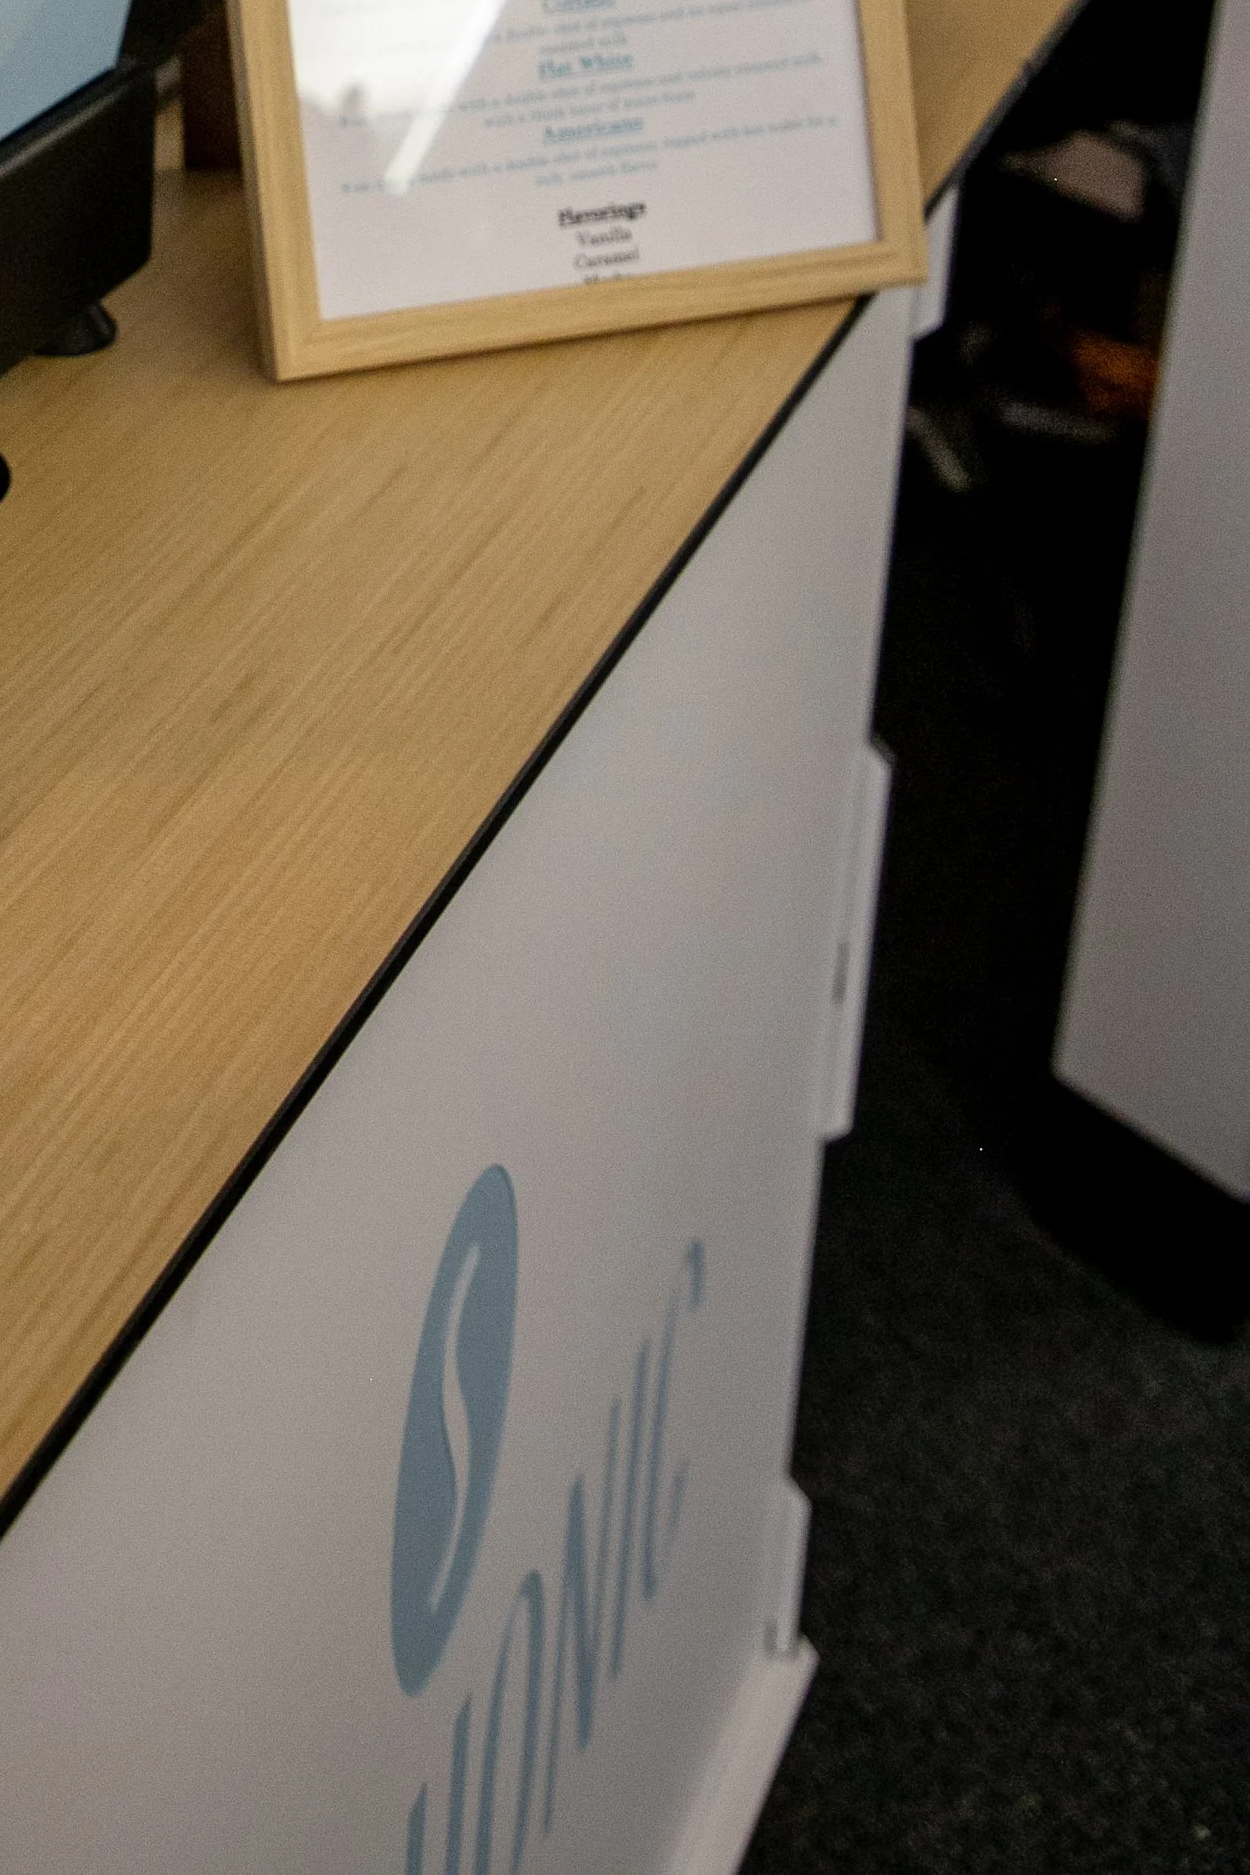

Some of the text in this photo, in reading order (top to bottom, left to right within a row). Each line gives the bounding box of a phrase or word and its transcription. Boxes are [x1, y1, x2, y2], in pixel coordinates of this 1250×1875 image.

[538, 52, 634, 82] Flat White
[542, 117, 645, 146] Americano
[575, 226, 633, 247] Vanilla
[573, 246, 640, 271] Caramel
